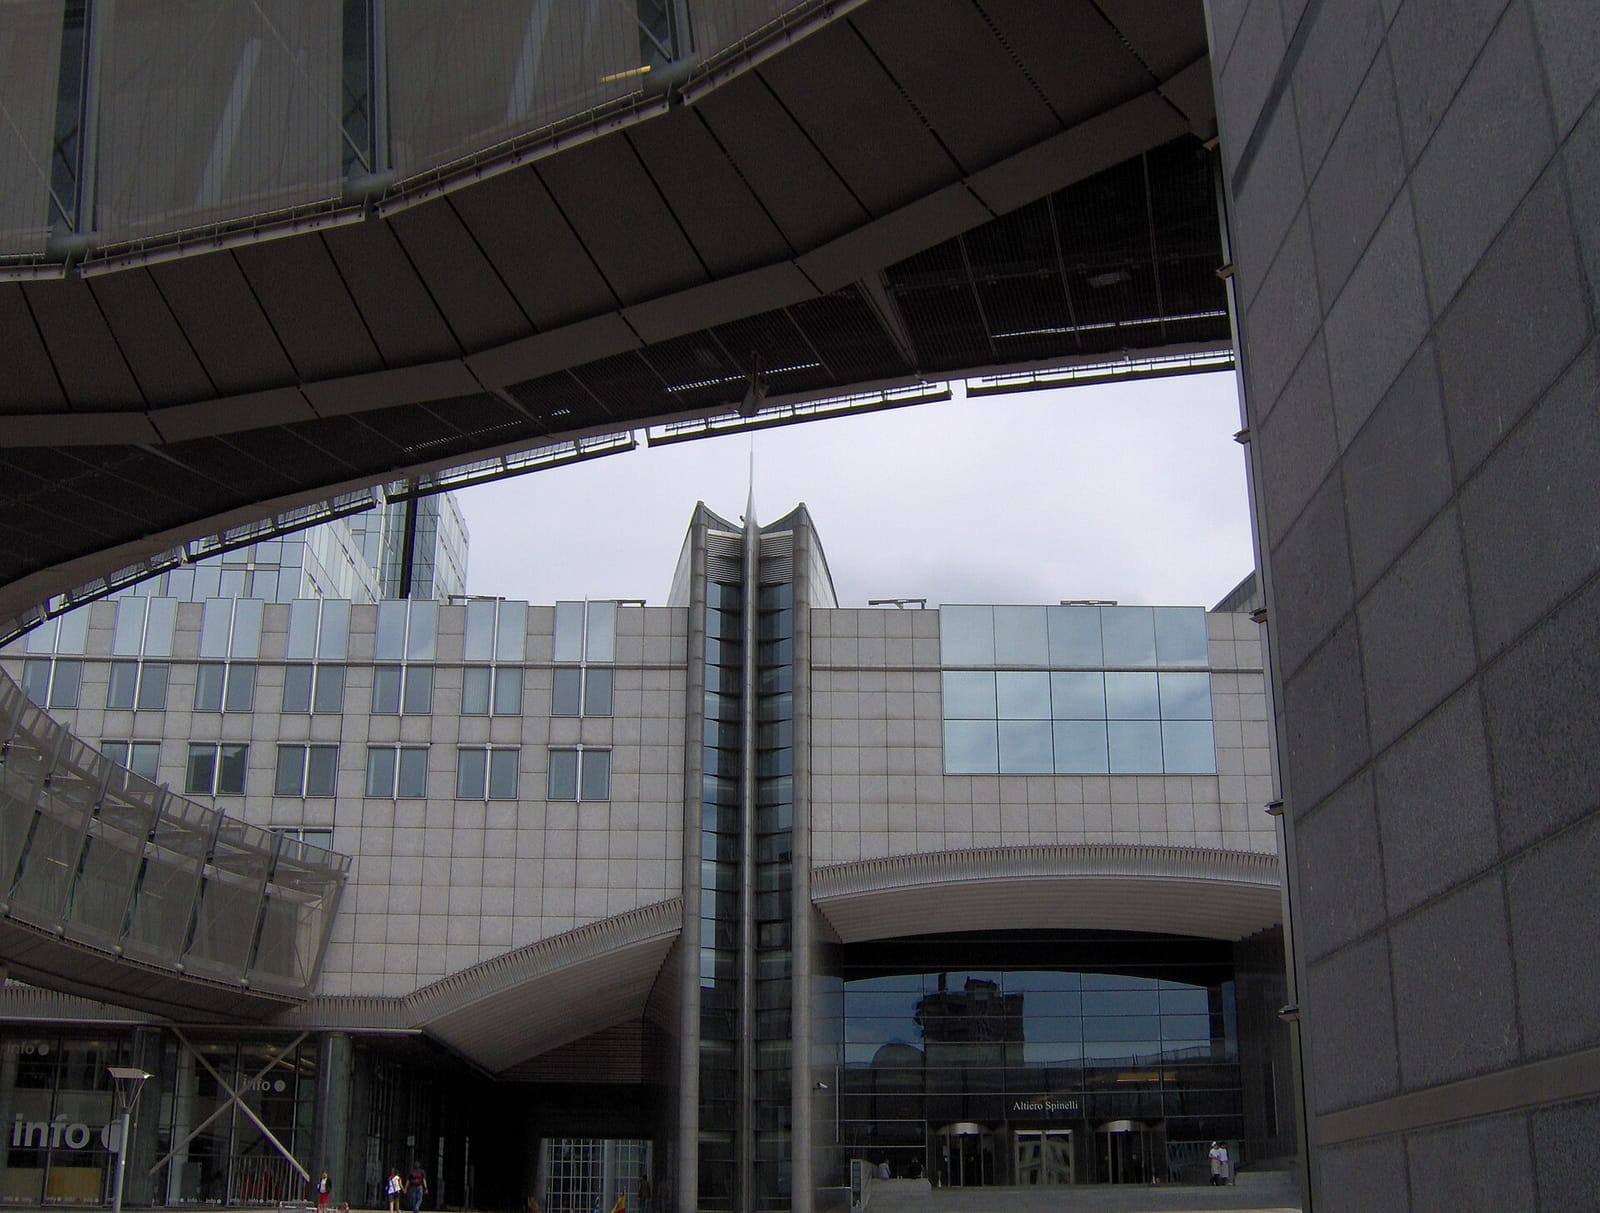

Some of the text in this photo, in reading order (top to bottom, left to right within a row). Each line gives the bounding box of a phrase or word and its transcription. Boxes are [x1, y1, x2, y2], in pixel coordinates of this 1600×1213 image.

[1013, 1100, 1079, 1113] Altiero Spinelli
[13, 1113, 91, 1150] info
